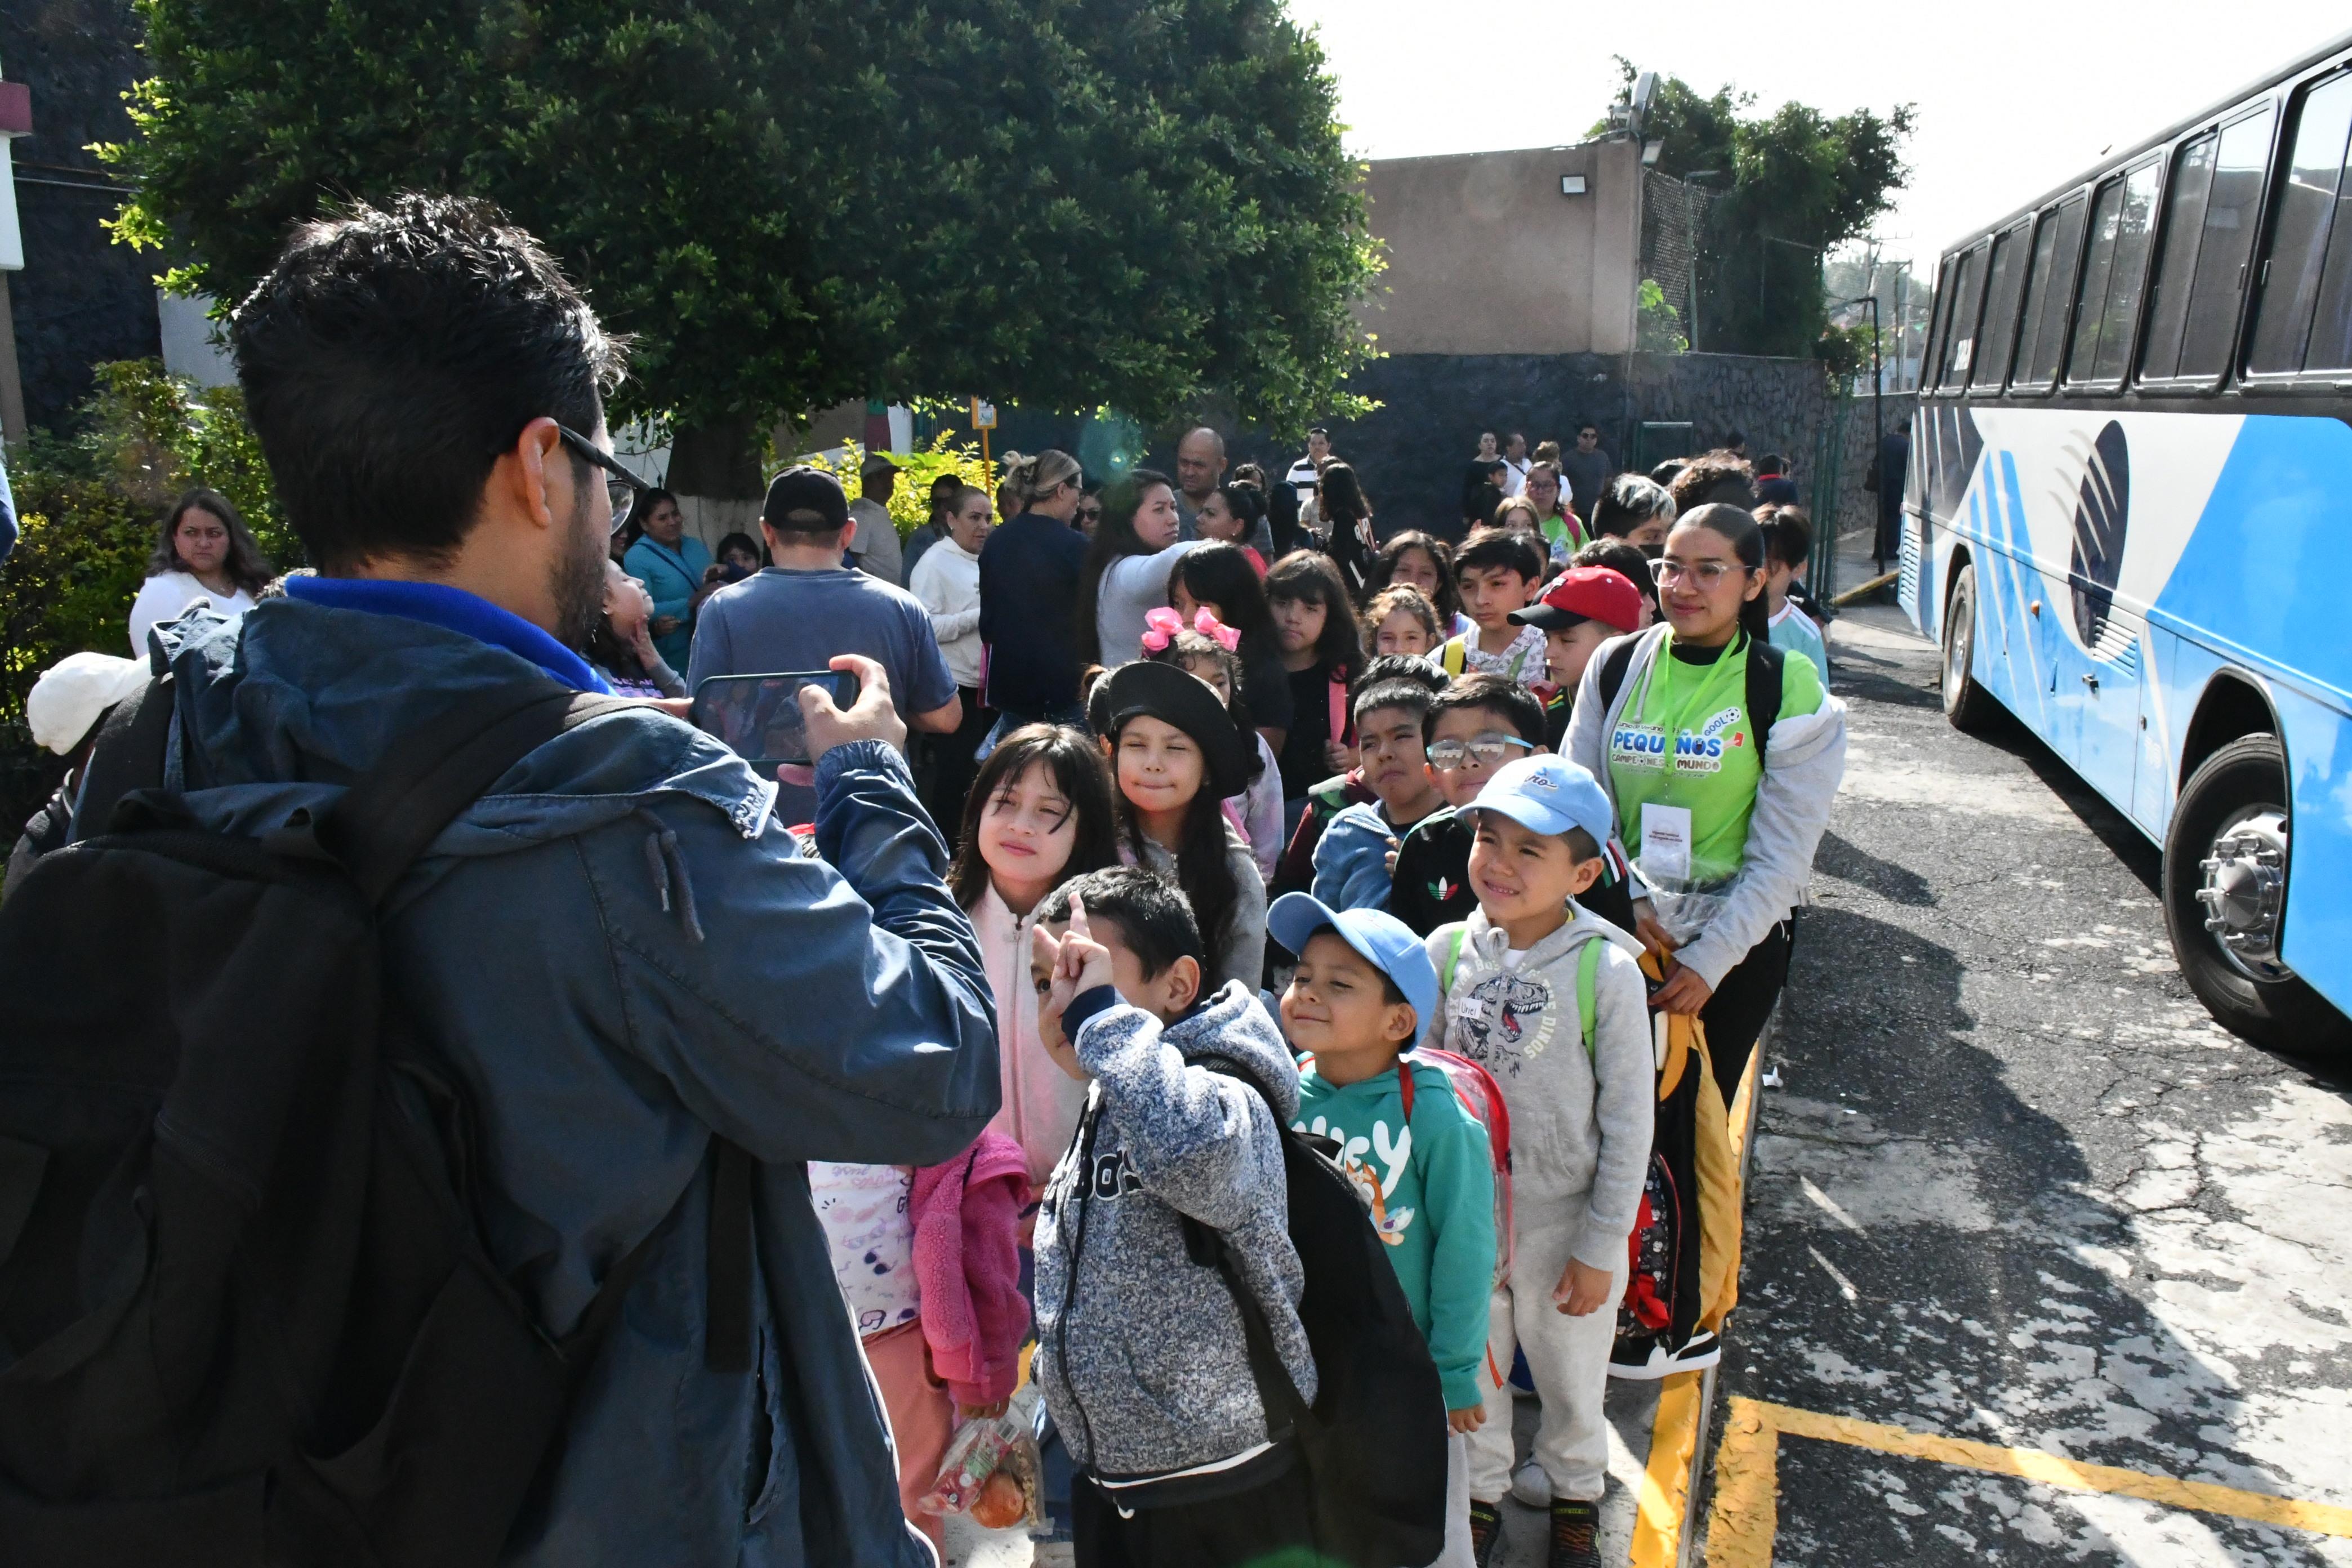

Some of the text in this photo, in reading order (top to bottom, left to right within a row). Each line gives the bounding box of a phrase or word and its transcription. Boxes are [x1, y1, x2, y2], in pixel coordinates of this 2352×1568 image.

[1704, 717, 1728, 736] GOOL
[1613, 732, 1721, 757] PEQUÑOS
[1677, 759, 1720, 770] MUNDO
[1460, 1001, 1476, 1016] Uriel
[1524, 1015, 1557, 1059] DINOS
